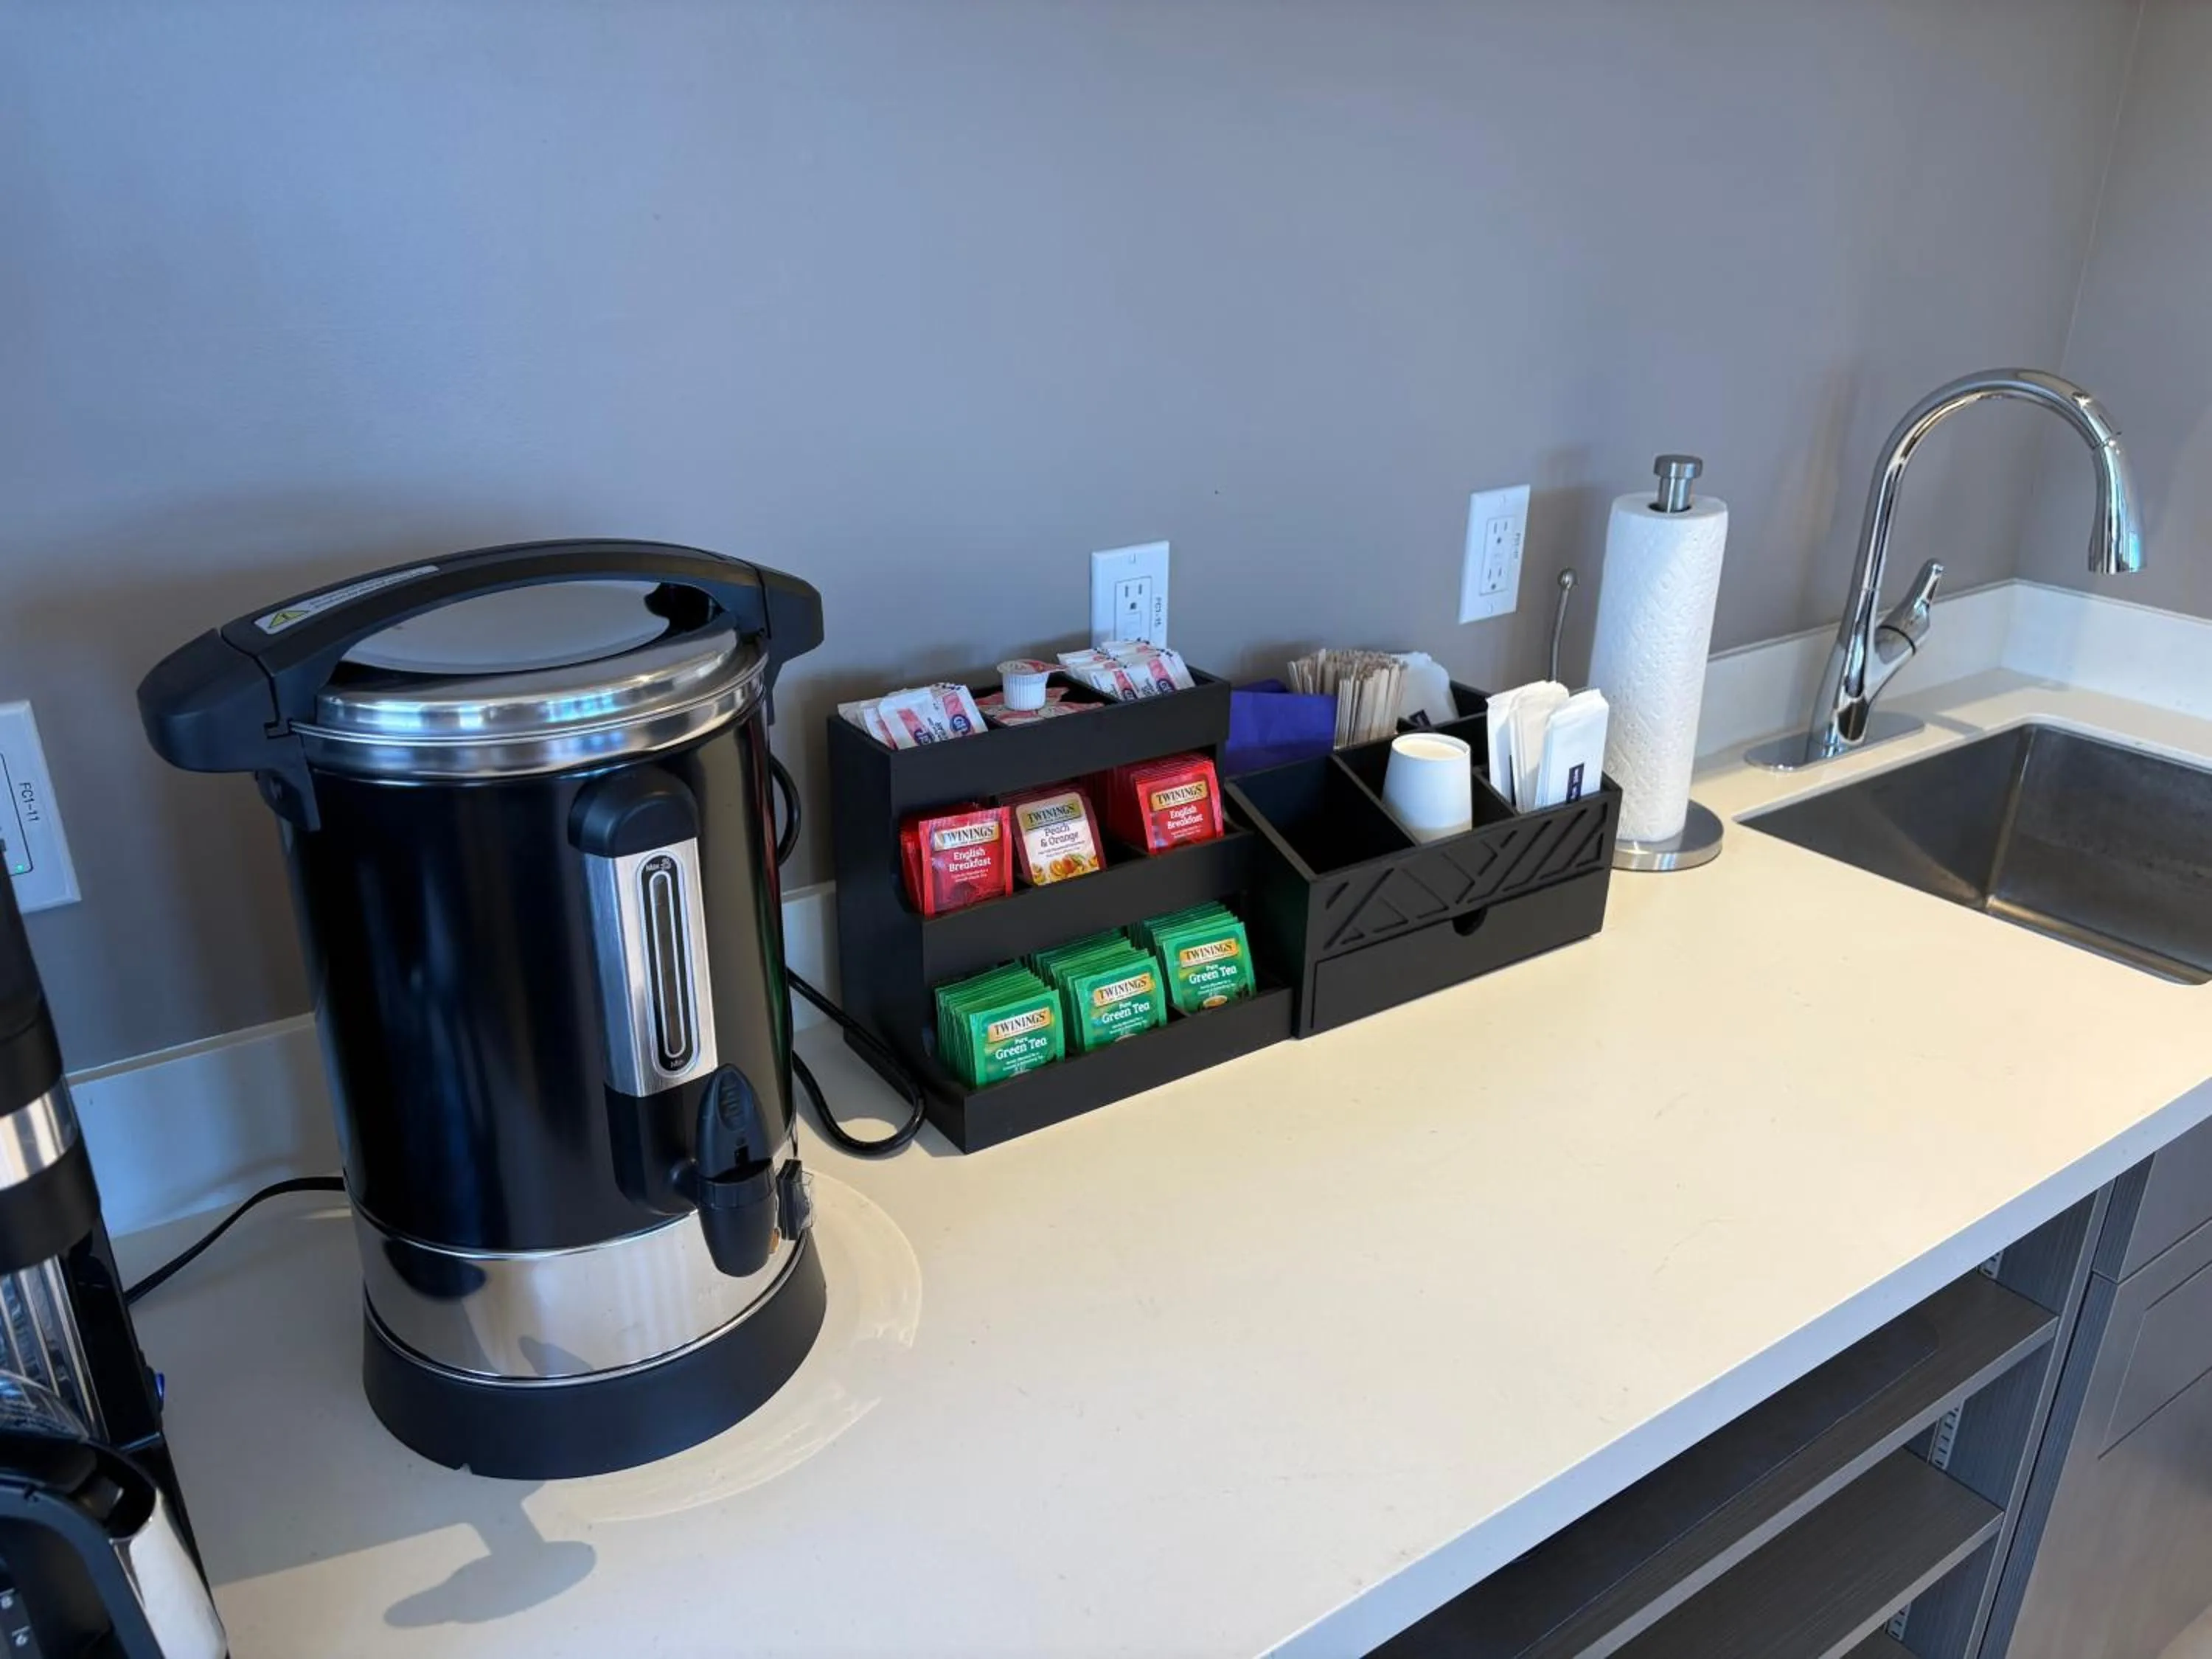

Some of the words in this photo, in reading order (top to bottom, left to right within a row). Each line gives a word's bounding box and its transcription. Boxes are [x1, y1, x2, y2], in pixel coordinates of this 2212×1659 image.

[18, 782, 41, 821] FC1-11
[1155, 784, 1203, 804] TWININGS
[1027, 803, 1074, 824] TWININGS
[1167, 813, 1203, 830] Breakfast
[1169, 804, 1197, 819] English
[941, 824, 995, 844] TWININGS
[1044, 821, 1070, 837] Peach
[1040, 838, 1048, 847] &
[1048, 832, 1079, 846] Orange
[953, 846, 986, 861] English
[949, 857, 992, 872] Breakfast
[1183, 941, 1233, 961] TWININGS
[1189, 970, 1219, 984] Green
[1220, 965, 1238, 977] Tea
[1097, 975, 1147, 1000] TWININGS
[993, 1011, 1046, 1035] TWININGS
[1102, 1008, 1132, 1024] Green
[1133, 1002, 1150, 1014] Tea
[995, 1043, 1027, 1060] Green
[1028, 1037, 1047, 1049] Tea
